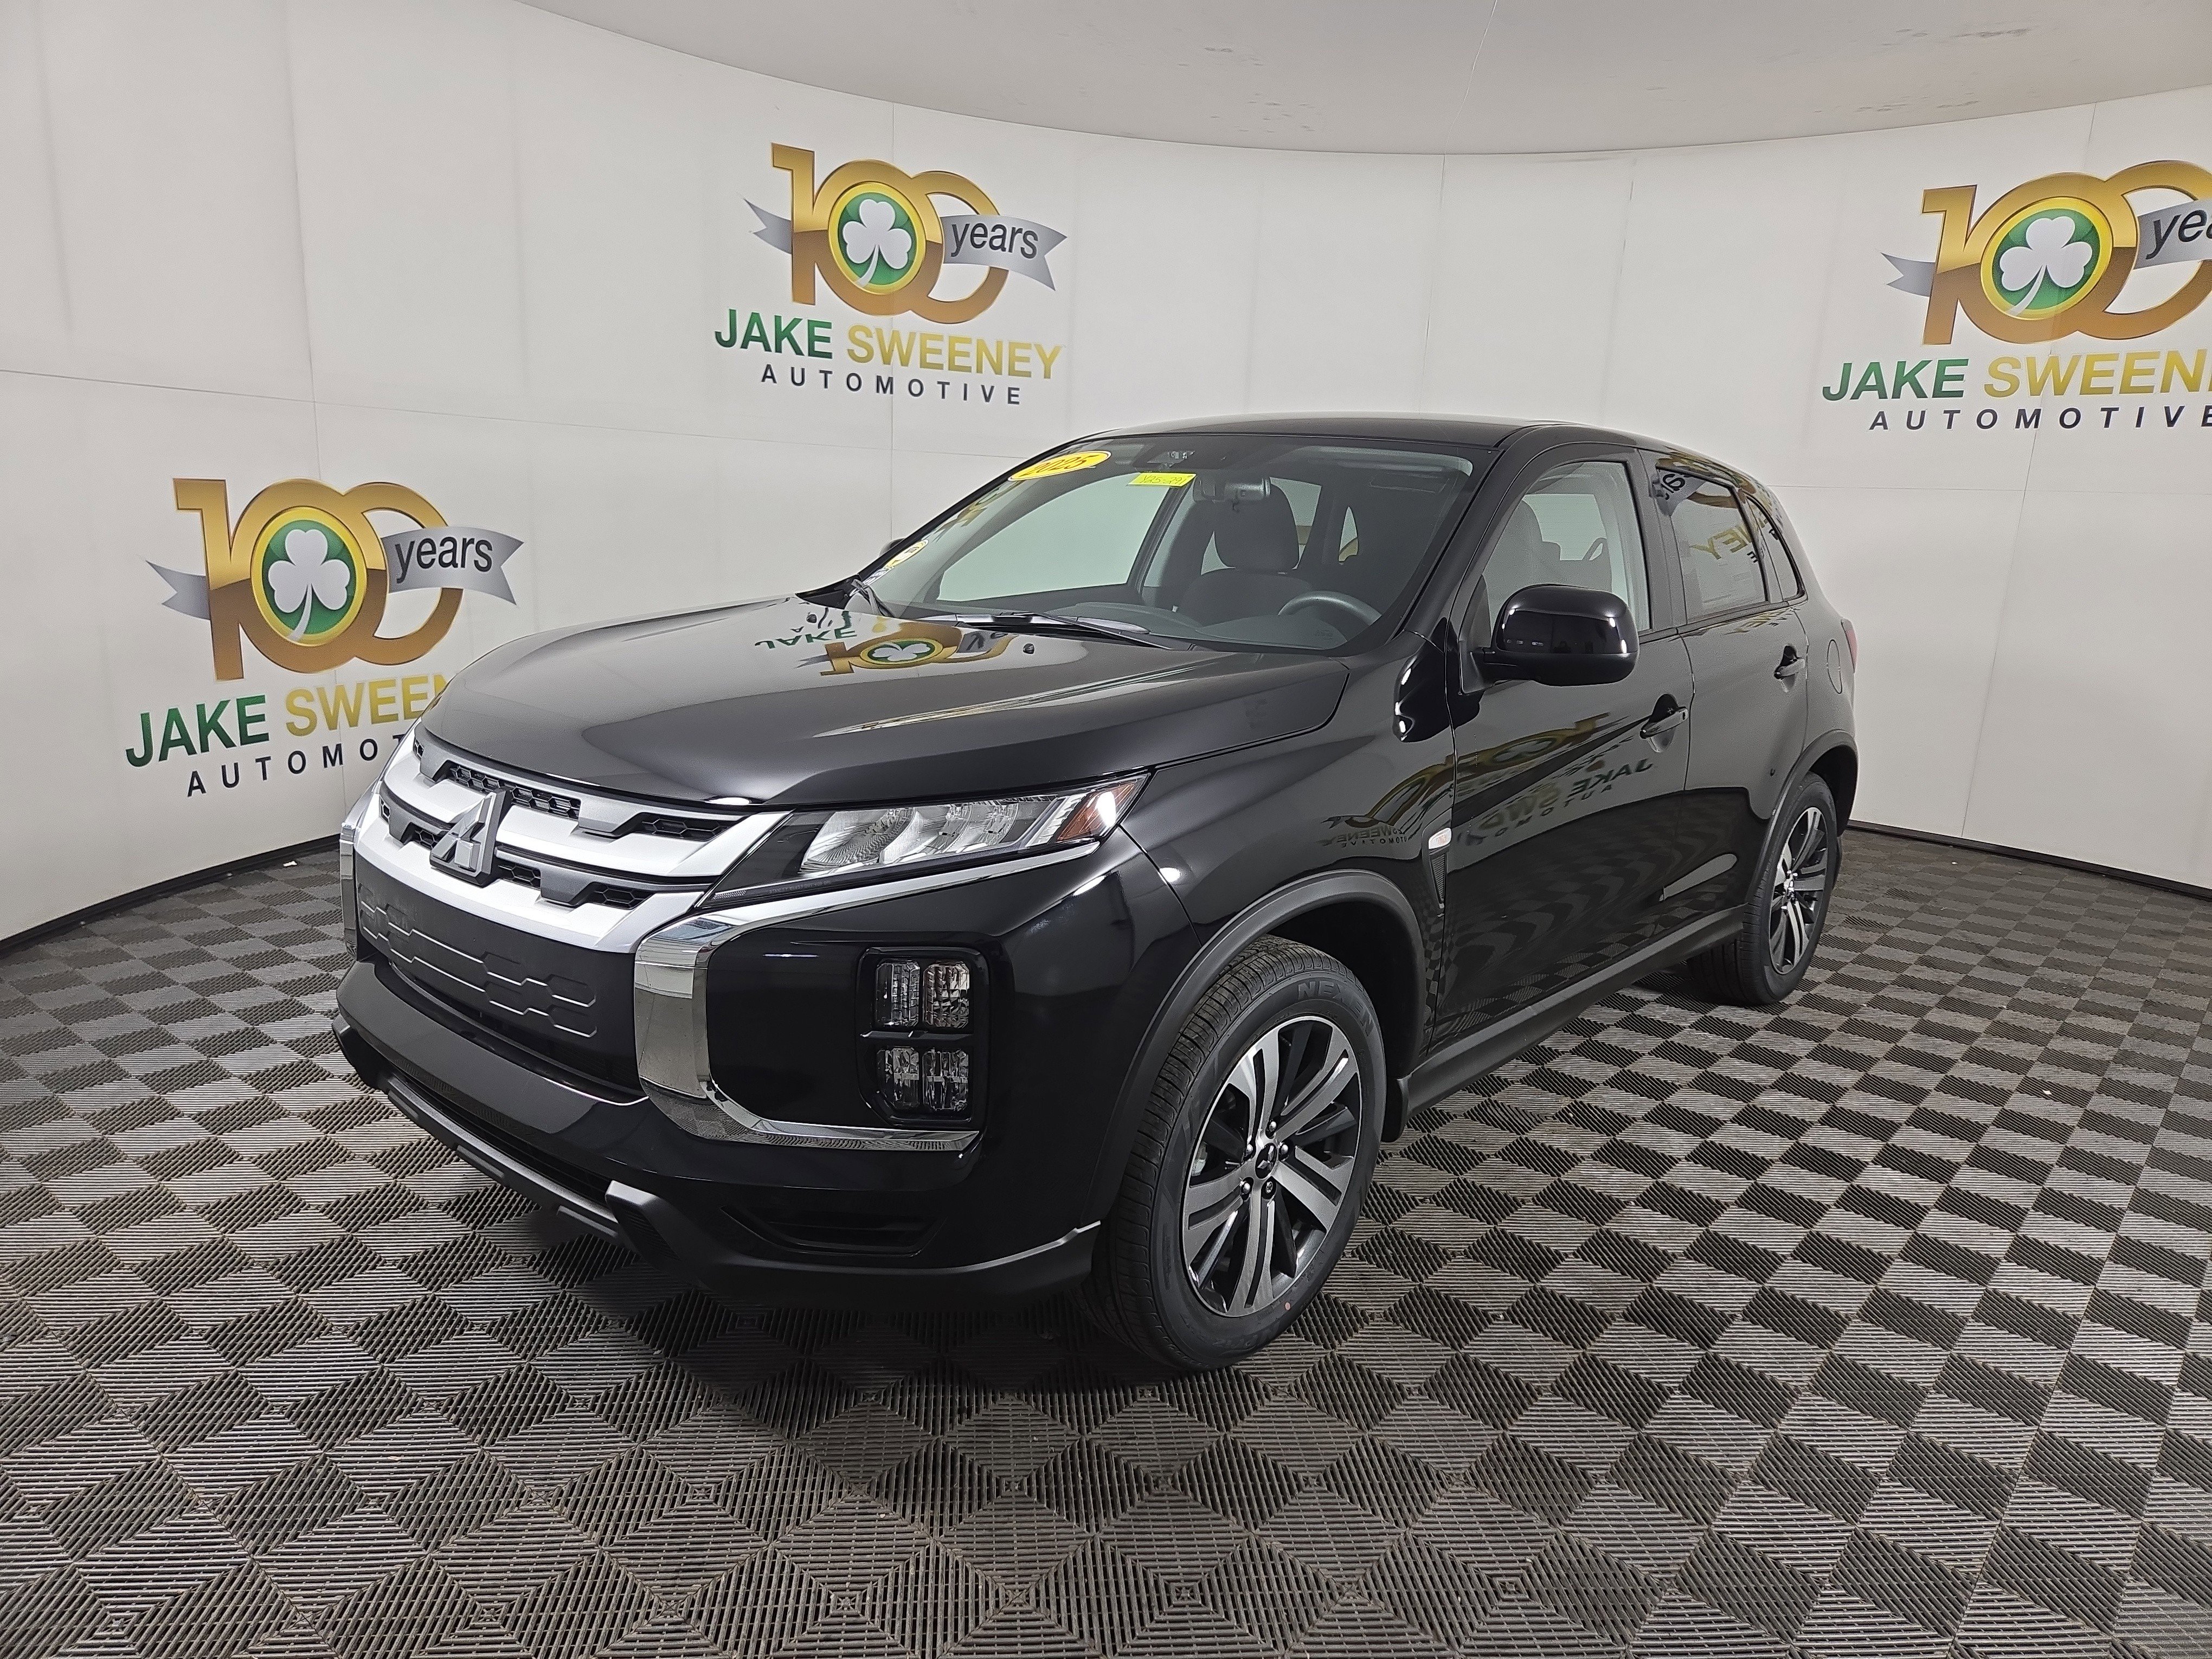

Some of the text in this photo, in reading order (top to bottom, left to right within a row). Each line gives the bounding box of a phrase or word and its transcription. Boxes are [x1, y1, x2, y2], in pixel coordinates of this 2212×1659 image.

[950, 222, 1039, 259] years
[2145, 209, 2212, 260] ye
[714, 308, 1063, 380] JAKE SWEENEY
[761, 363, 1020, 406] AUTOMOTIVE
[1822, 349, 2212, 401] JAKE SWEEN
[1019, 454, 1099, 478] 2025
[394, 536, 494, 584] years
[125, 694, 269, 768] JAKE
